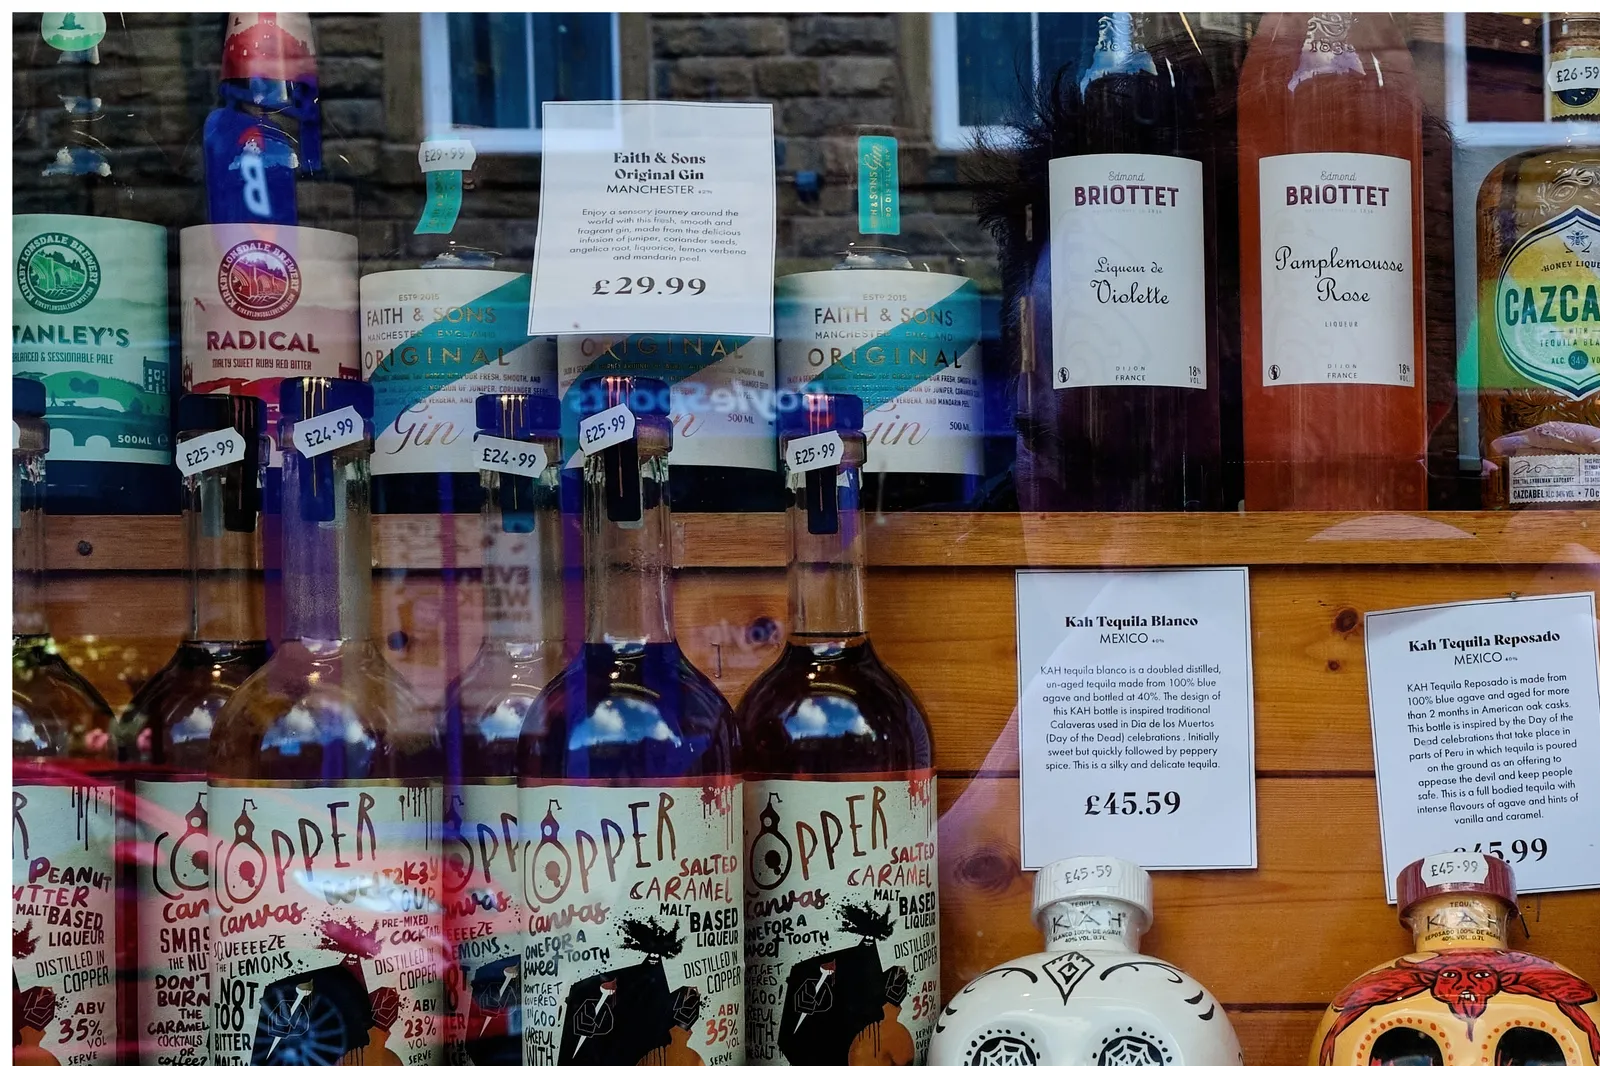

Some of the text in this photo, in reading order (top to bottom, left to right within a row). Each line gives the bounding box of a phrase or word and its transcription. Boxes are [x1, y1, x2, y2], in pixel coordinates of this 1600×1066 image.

[614, 152, 706, 164] Faith & Sons
[615, 169, 704, 182] Original Gin
[1108, 171, 1145, 182] Edmond
[607, 185, 694, 194] MANCHESTER
[1075, 185, 1179, 207] BRIOTTET
[1287, 185, 1389, 206] BRIOTTET
[1095, 257, 1163, 277] Liqueur de
[1275, 246, 1404, 278] Pamplemousse
[592, 276, 706, 295] £29.99
[1090, 280, 1169, 304] Violette
[1317, 277, 1370, 302] Rose
[815, 307, 952, 326] FAITH & SONS
[207, 331, 319, 353] RADICAL
[212, 358, 311, 370] MALTY SWEET RUBY RED BITTER
[808, 347, 961, 372] ORIGINAL
[1065, 615, 1198, 630] Kah Tequila Blanco
[1100, 633, 1148, 643] MEXICO
[1409, 631, 1560, 652] Kah Tequila Reposado
[1041, 665, 1126, 676] KAH tequila blanco
[1084, 791, 1181, 815] £45.59
[679, 854, 737, 877] SALTED
[630, 877, 732, 903] CARAMEL
[660, 903, 738, 933] MALT BASED
[697, 931, 738, 947] LIQUEUR
